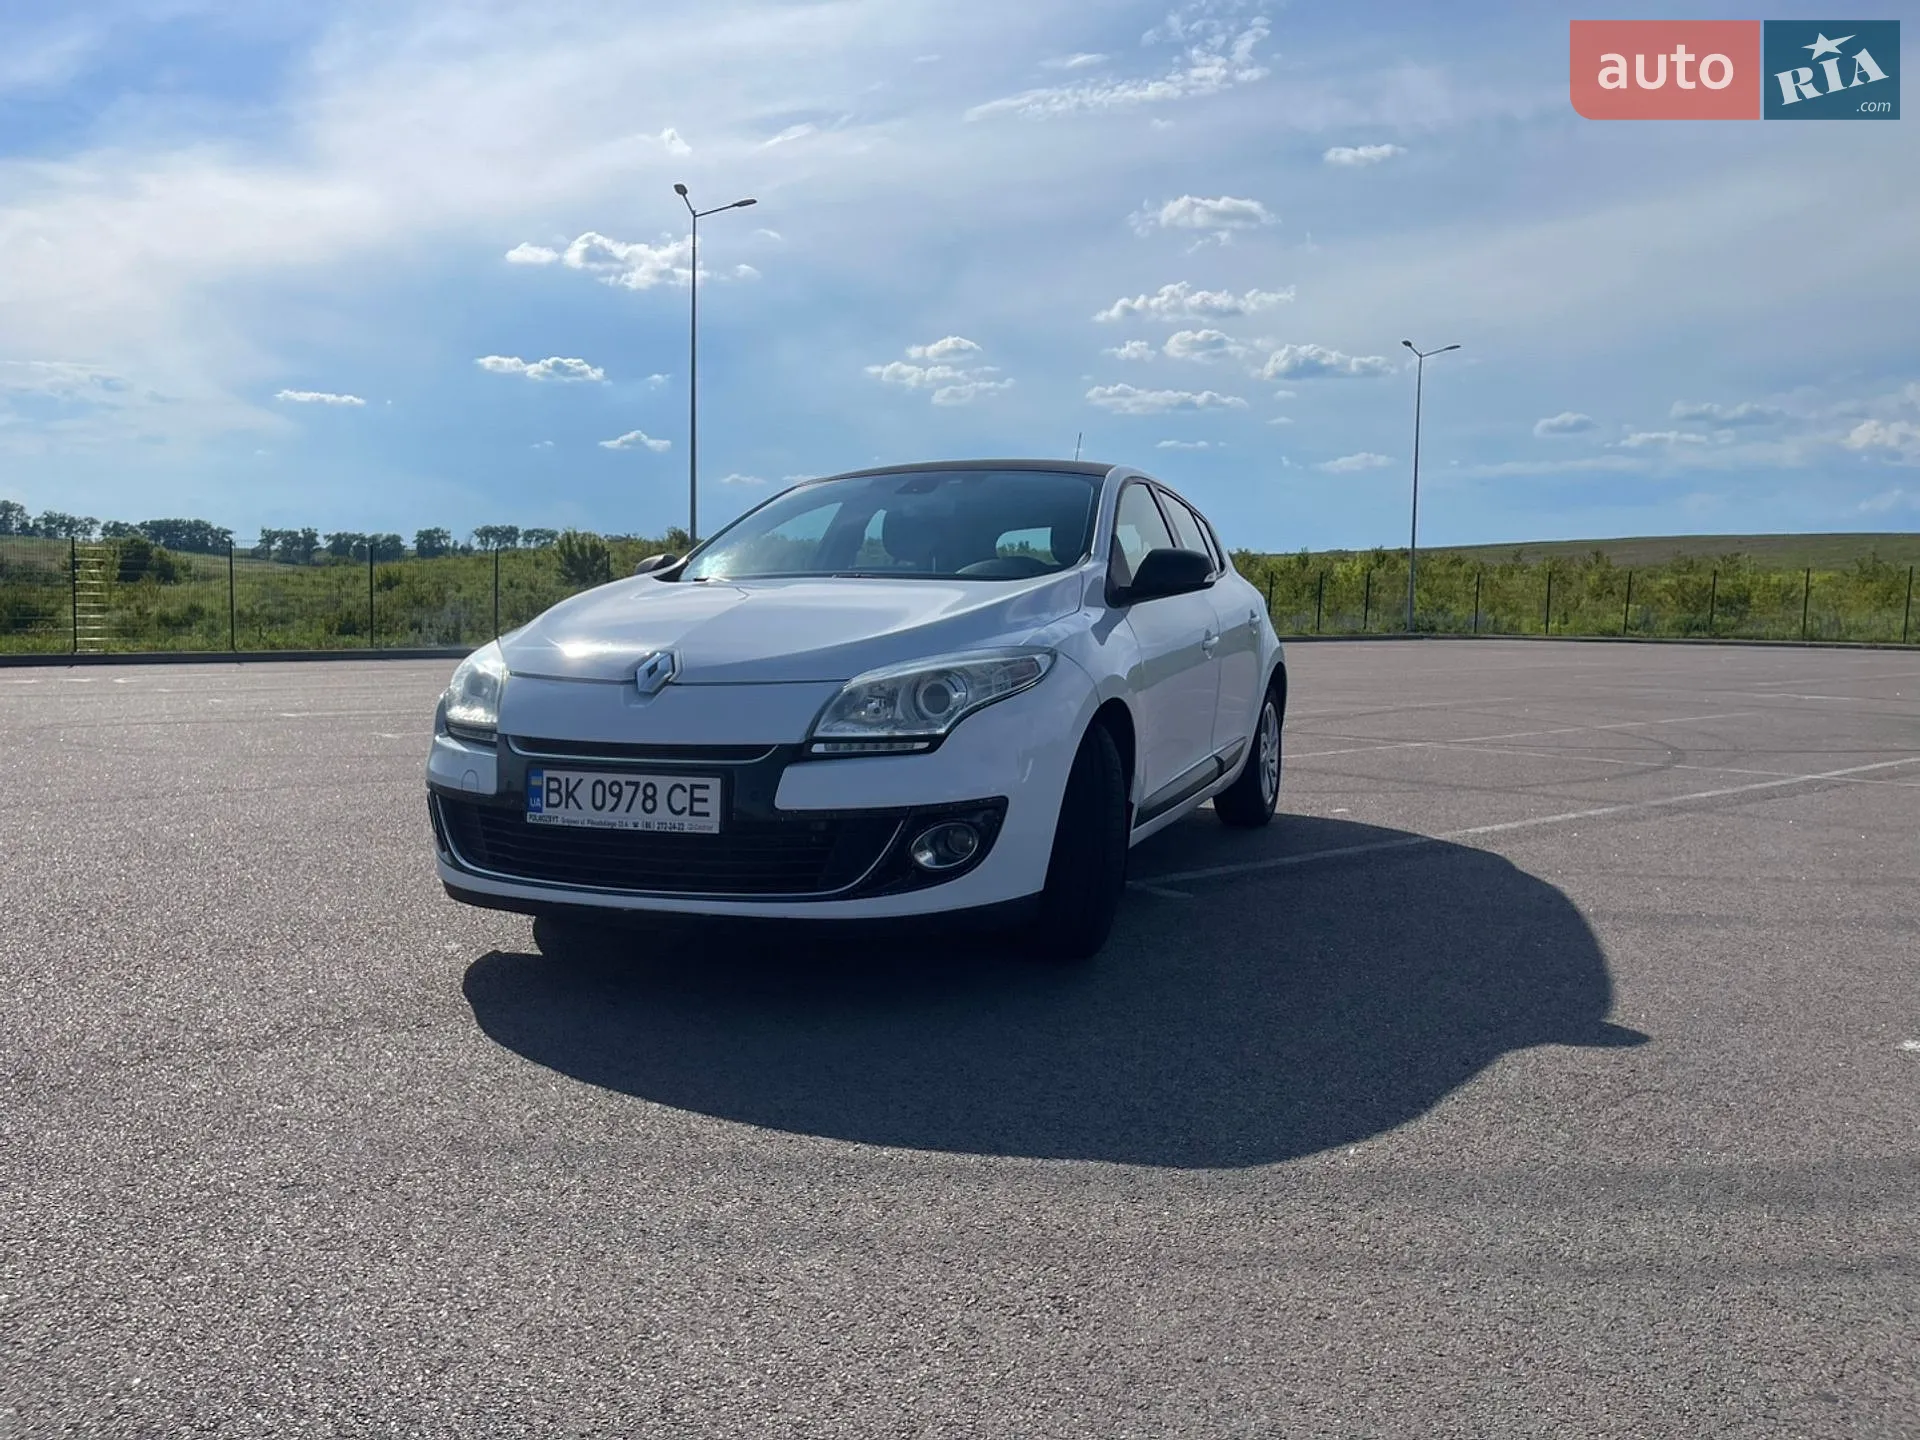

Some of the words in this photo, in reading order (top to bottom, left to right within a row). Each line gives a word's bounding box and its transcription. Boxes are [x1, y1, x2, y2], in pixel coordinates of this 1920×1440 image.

[529, 797, 542, 808] UA
[545, 776, 584, 810] BK
[591, 779, 657, 814] 0978
[666, 783, 710, 817] CE
